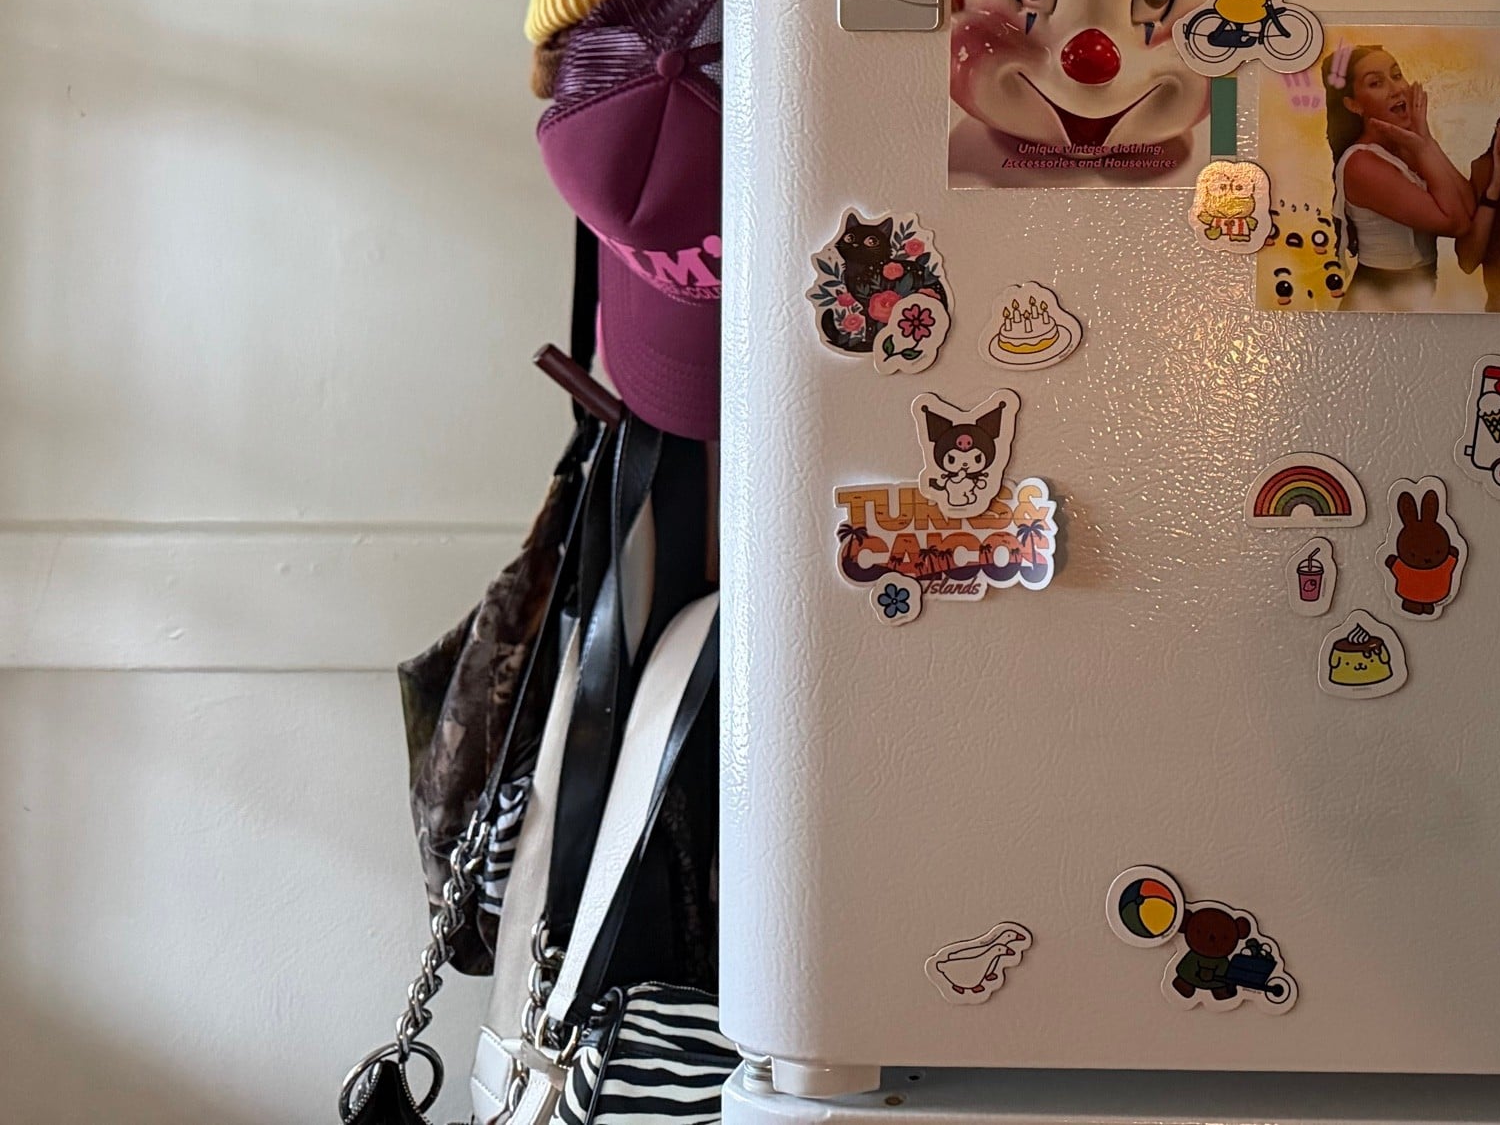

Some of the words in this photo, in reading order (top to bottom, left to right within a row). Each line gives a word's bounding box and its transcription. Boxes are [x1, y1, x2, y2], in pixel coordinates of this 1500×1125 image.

[1018, 143, 1060, 155] Unique
[1064, 143, 1107, 155] vintage
[1003, 158, 1075, 169] Accessories
[1078, 158, 1101, 168] and
[1105, 158, 1177, 168] Housewares
[841, 532, 1049, 583] CAICOS
[923, 576, 981, 595] Islands
